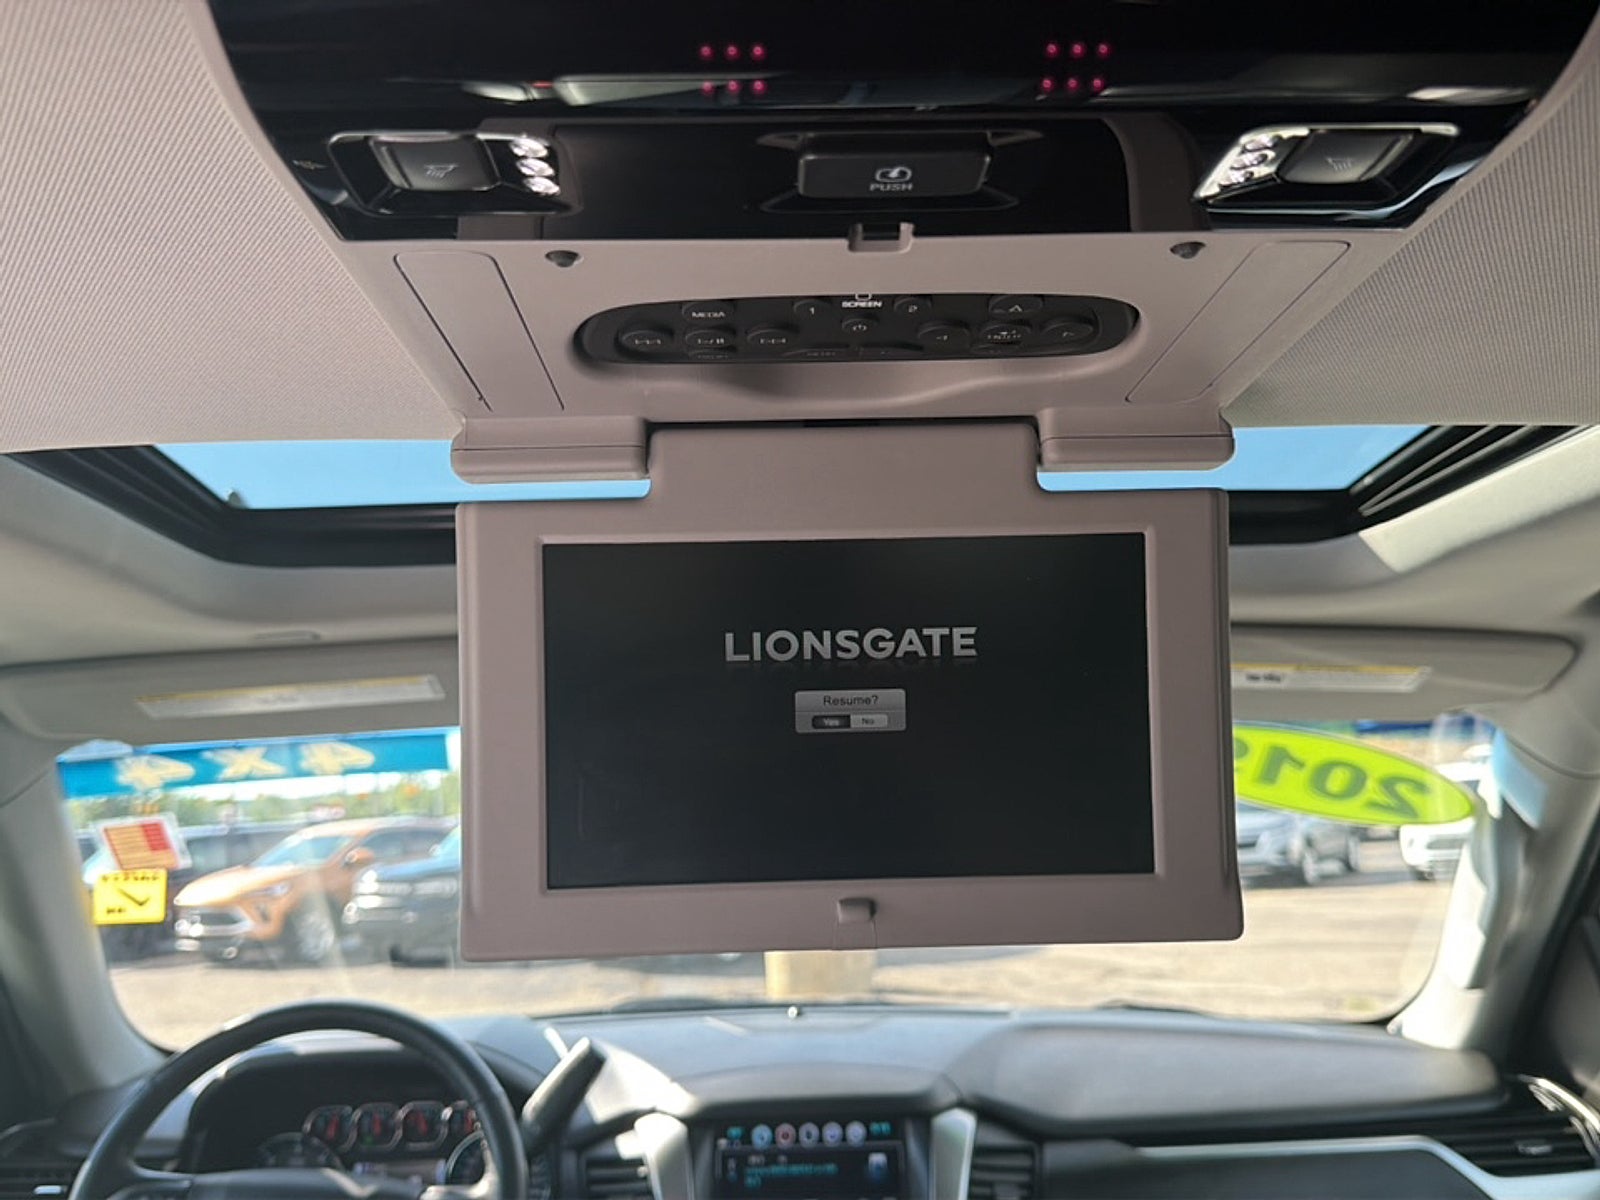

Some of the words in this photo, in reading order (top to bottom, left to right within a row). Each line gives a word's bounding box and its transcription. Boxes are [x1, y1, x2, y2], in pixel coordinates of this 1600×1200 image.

[869, 182, 914, 192] PUSH
[841, 300, 883, 309] SCREEN
[691, 311, 727, 319] MEDIA
[724, 626, 978, 663] LIONSGATE
[822, 694, 879, 707] Resume?
[822, 717, 840, 727] Yes
[861, 716, 875, 726] No
